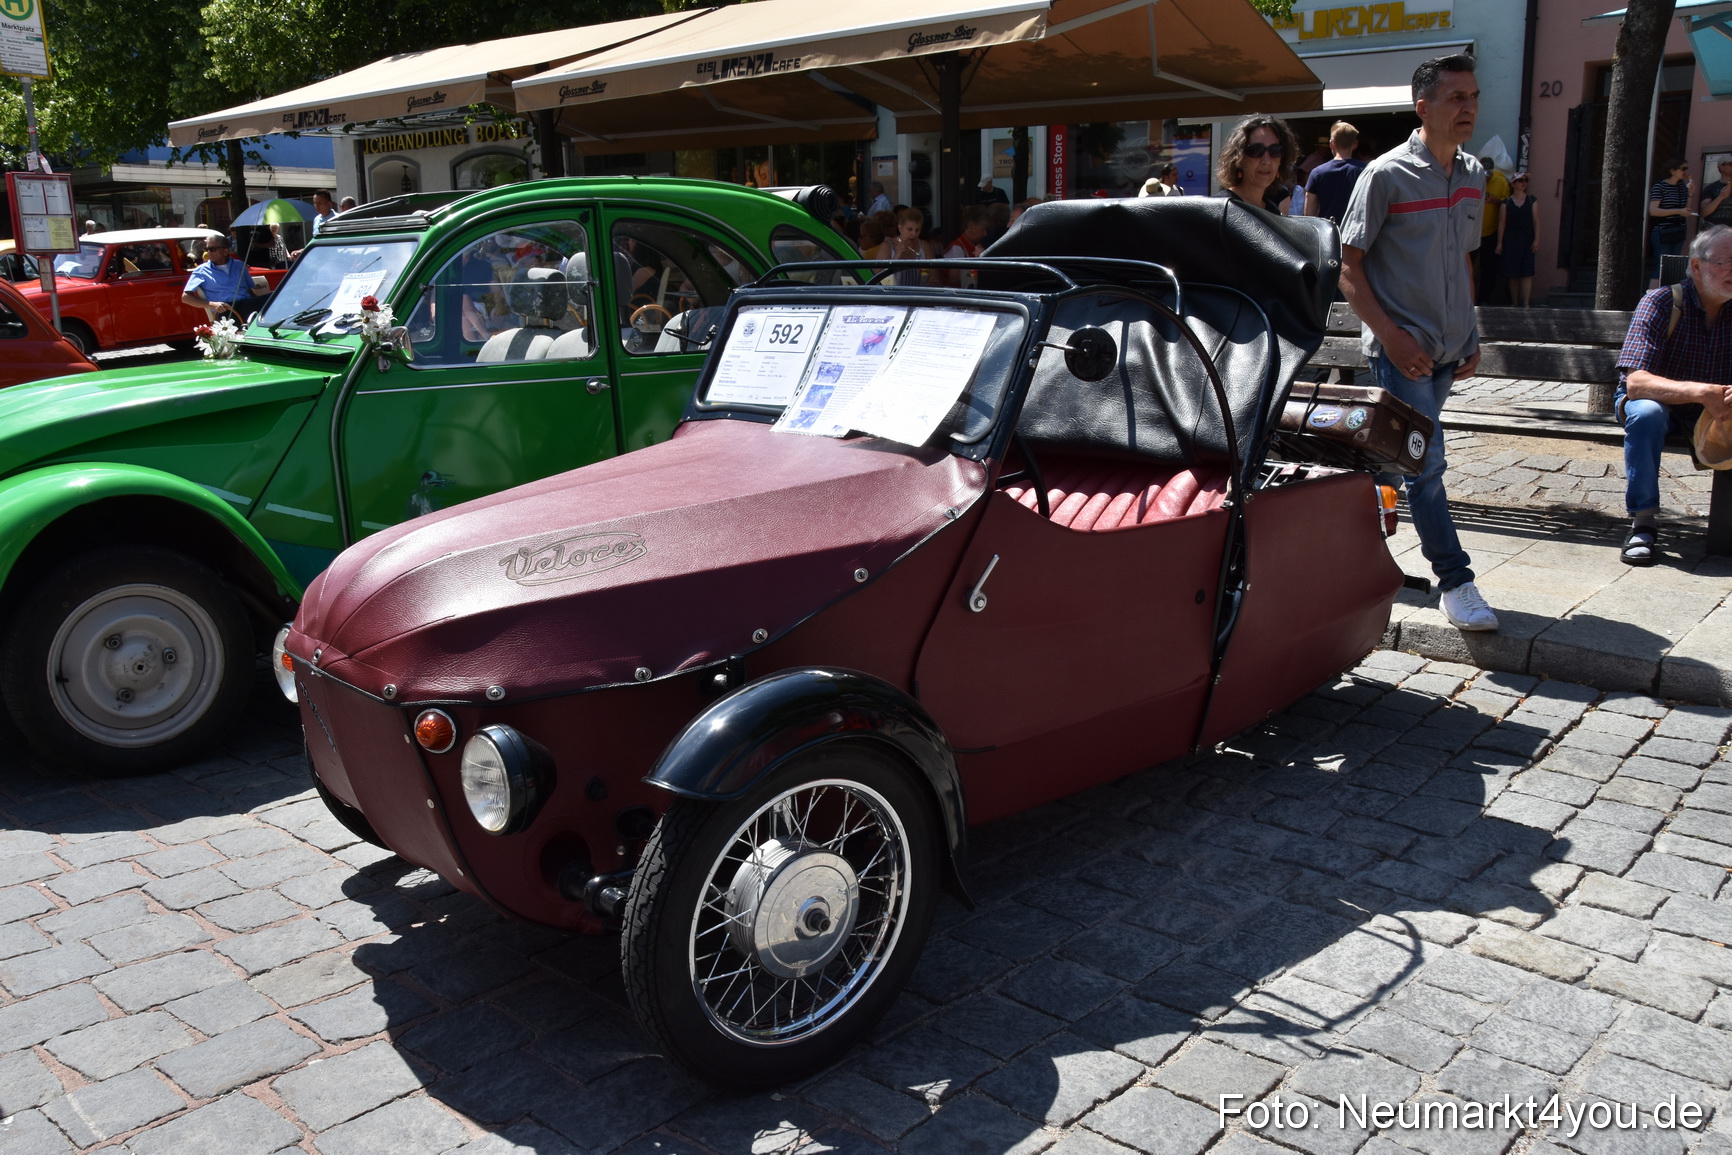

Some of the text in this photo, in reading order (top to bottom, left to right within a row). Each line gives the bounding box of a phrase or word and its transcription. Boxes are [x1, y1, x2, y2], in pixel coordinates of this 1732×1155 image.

[1, 22, 35, 32] Marktplatz
[1298, 2, 1405, 40] LORENZO
[1404, 11, 1452, 30] CAFE
[907, 25, 977, 53] Glossner-Bier
[697, 53, 801, 80] EIS LORENZO CAFE
[559, 80, 607, 104] Glossner-Bier
[1539, 80, 1563, 98] 20
[407, 90, 447, 113] Glossner-Bier
[293, 108, 329, 129] LORENZO
[1053, 134, 1064, 165] Store
[769, 323, 804, 345] 592
[1411, 436, 1422, 453] HR
[499, 536, 647, 583] Velorex
